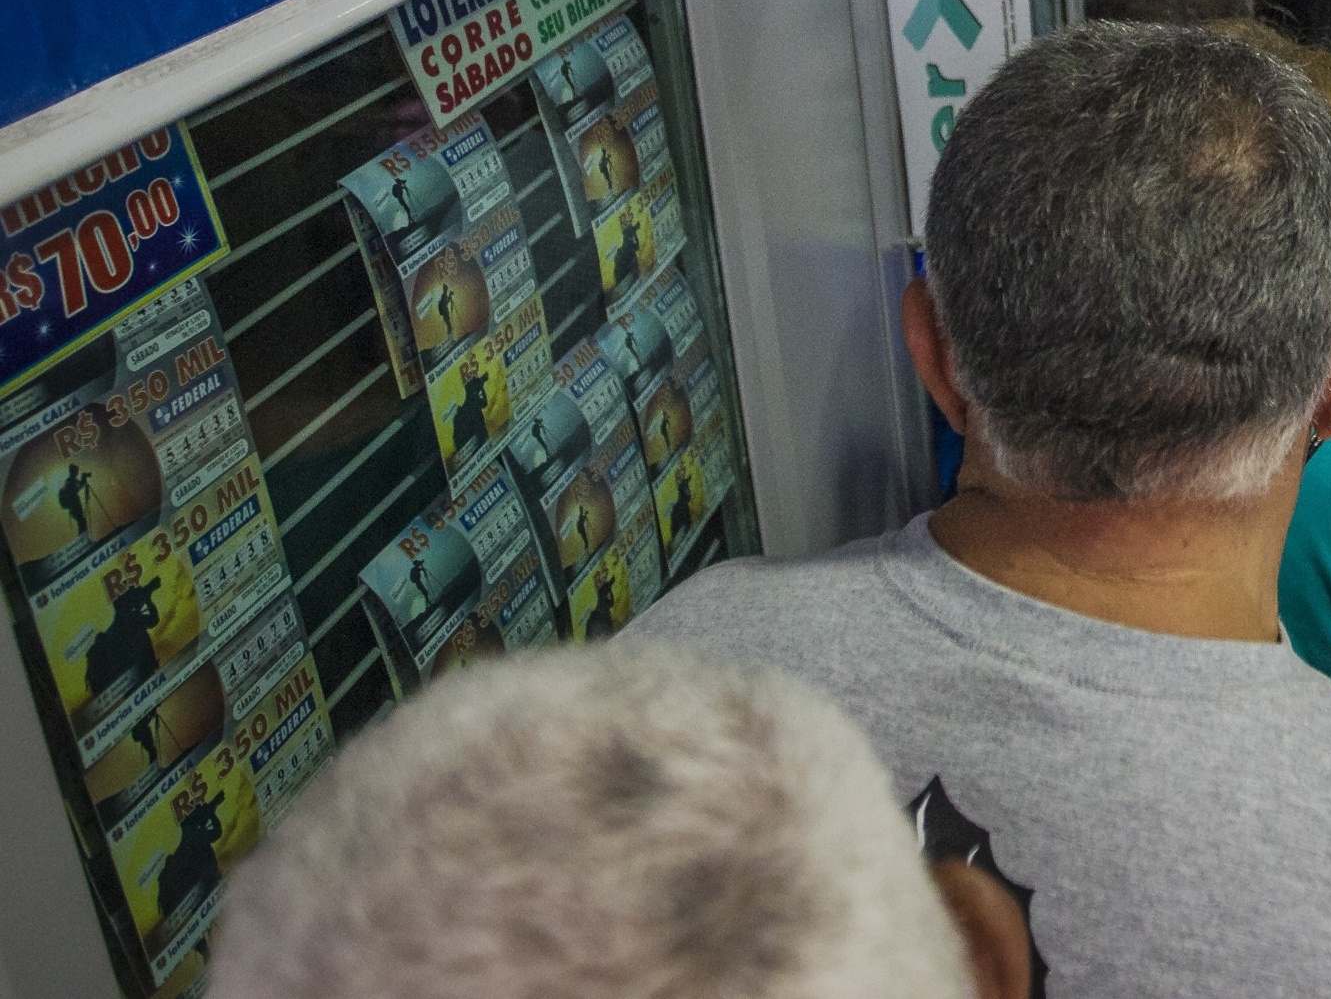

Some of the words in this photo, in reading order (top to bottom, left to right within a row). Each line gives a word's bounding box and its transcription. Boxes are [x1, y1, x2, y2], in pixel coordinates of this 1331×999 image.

[537, 11, 565, 44] SEU
[436, 32, 533, 114] SÁBADO
[455, 129, 485, 159] FEDERAL
[53, 410, 100, 459] R$
[106, 370, 168, 428] 350
[175, 336, 226, 385] MIL
[171, 373, 221, 416] FEDERAL
[475, 483, 504, 519] FEDERAL
[103, 552, 143, 603] R$
[152, 505, 208, 565] 350
[214, 465, 260, 514] MIL
[209, 501, 256, 550] FEDERAL
[398, 526, 429, 559] R$
[134, 672, 167, 706] CAIXA
[170, 773, 208, 825] R$
[214, 713, 268, 780] 350
[273, 667, 315, 717] MIL
[269, 703, 313, 752] FEDERAL
